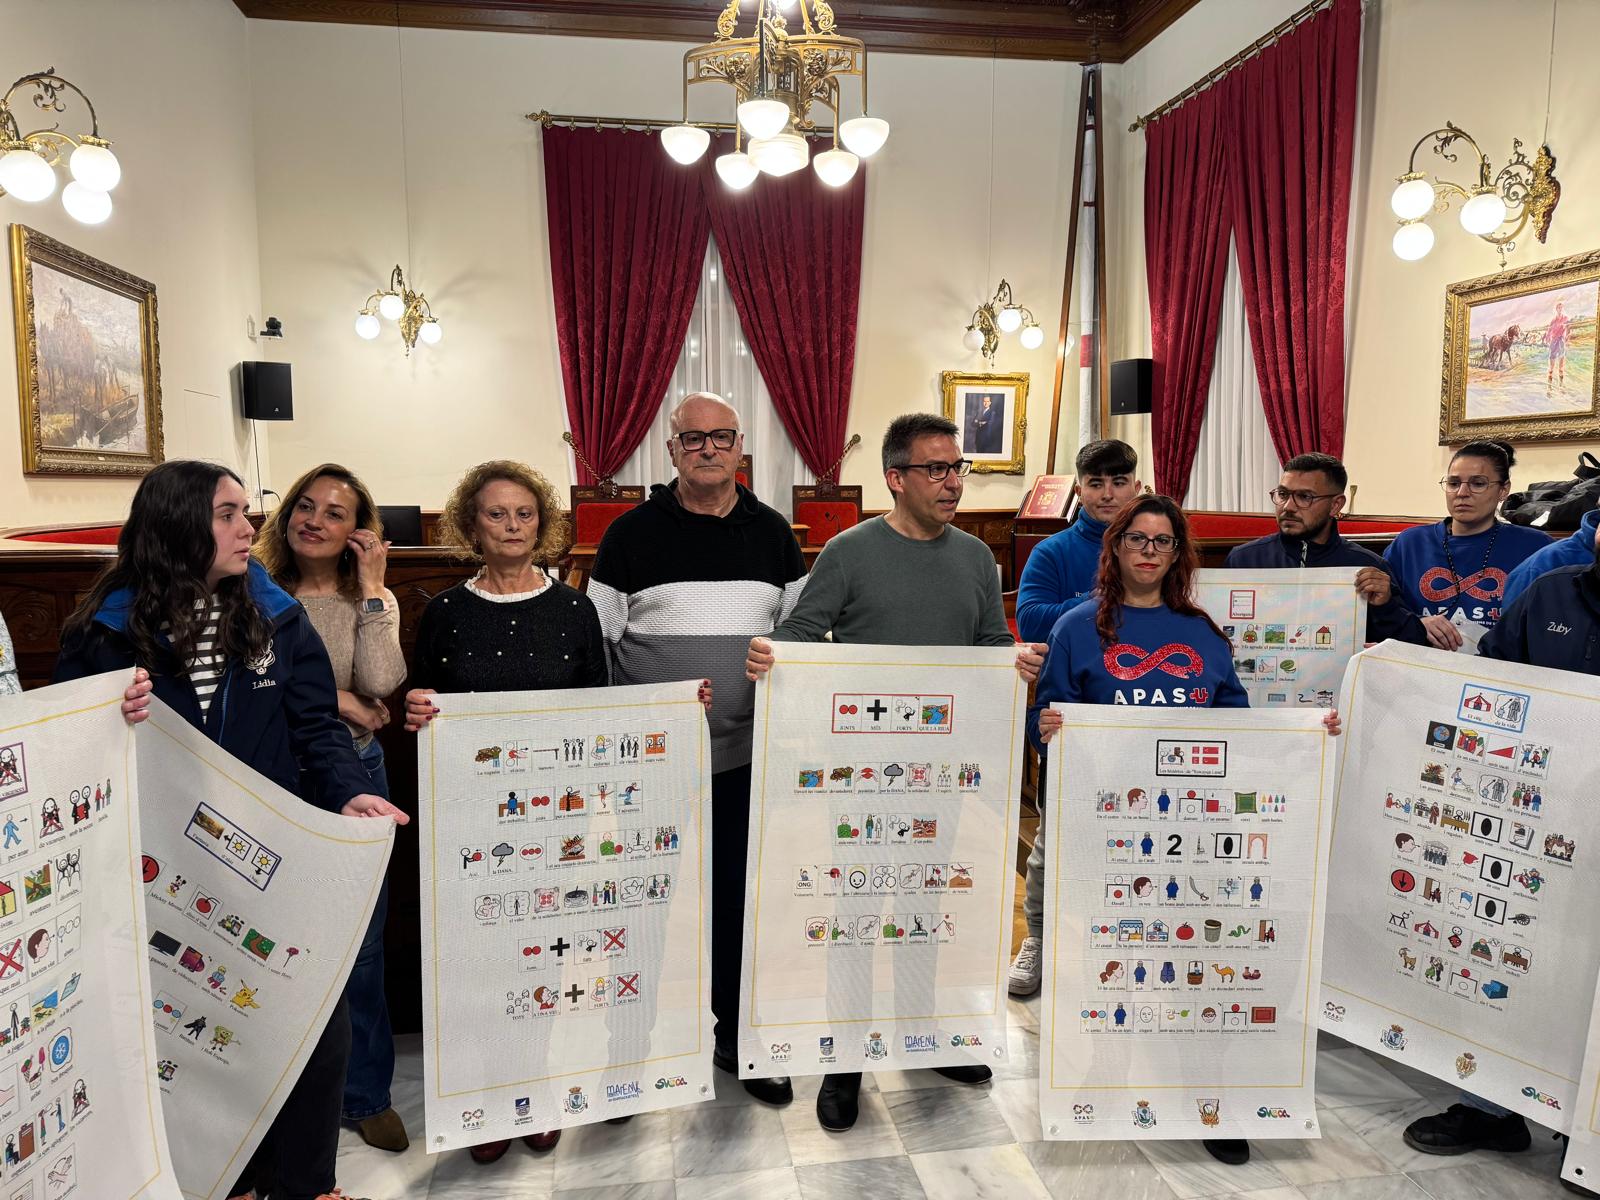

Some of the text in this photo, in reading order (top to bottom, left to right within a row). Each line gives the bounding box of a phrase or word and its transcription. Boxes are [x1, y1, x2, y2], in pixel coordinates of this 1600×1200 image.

[1547, 622, 1572, 636] Zuby
[252, 679, 276, 690] Lidia
[1167, 834, 1182, 855] 2
